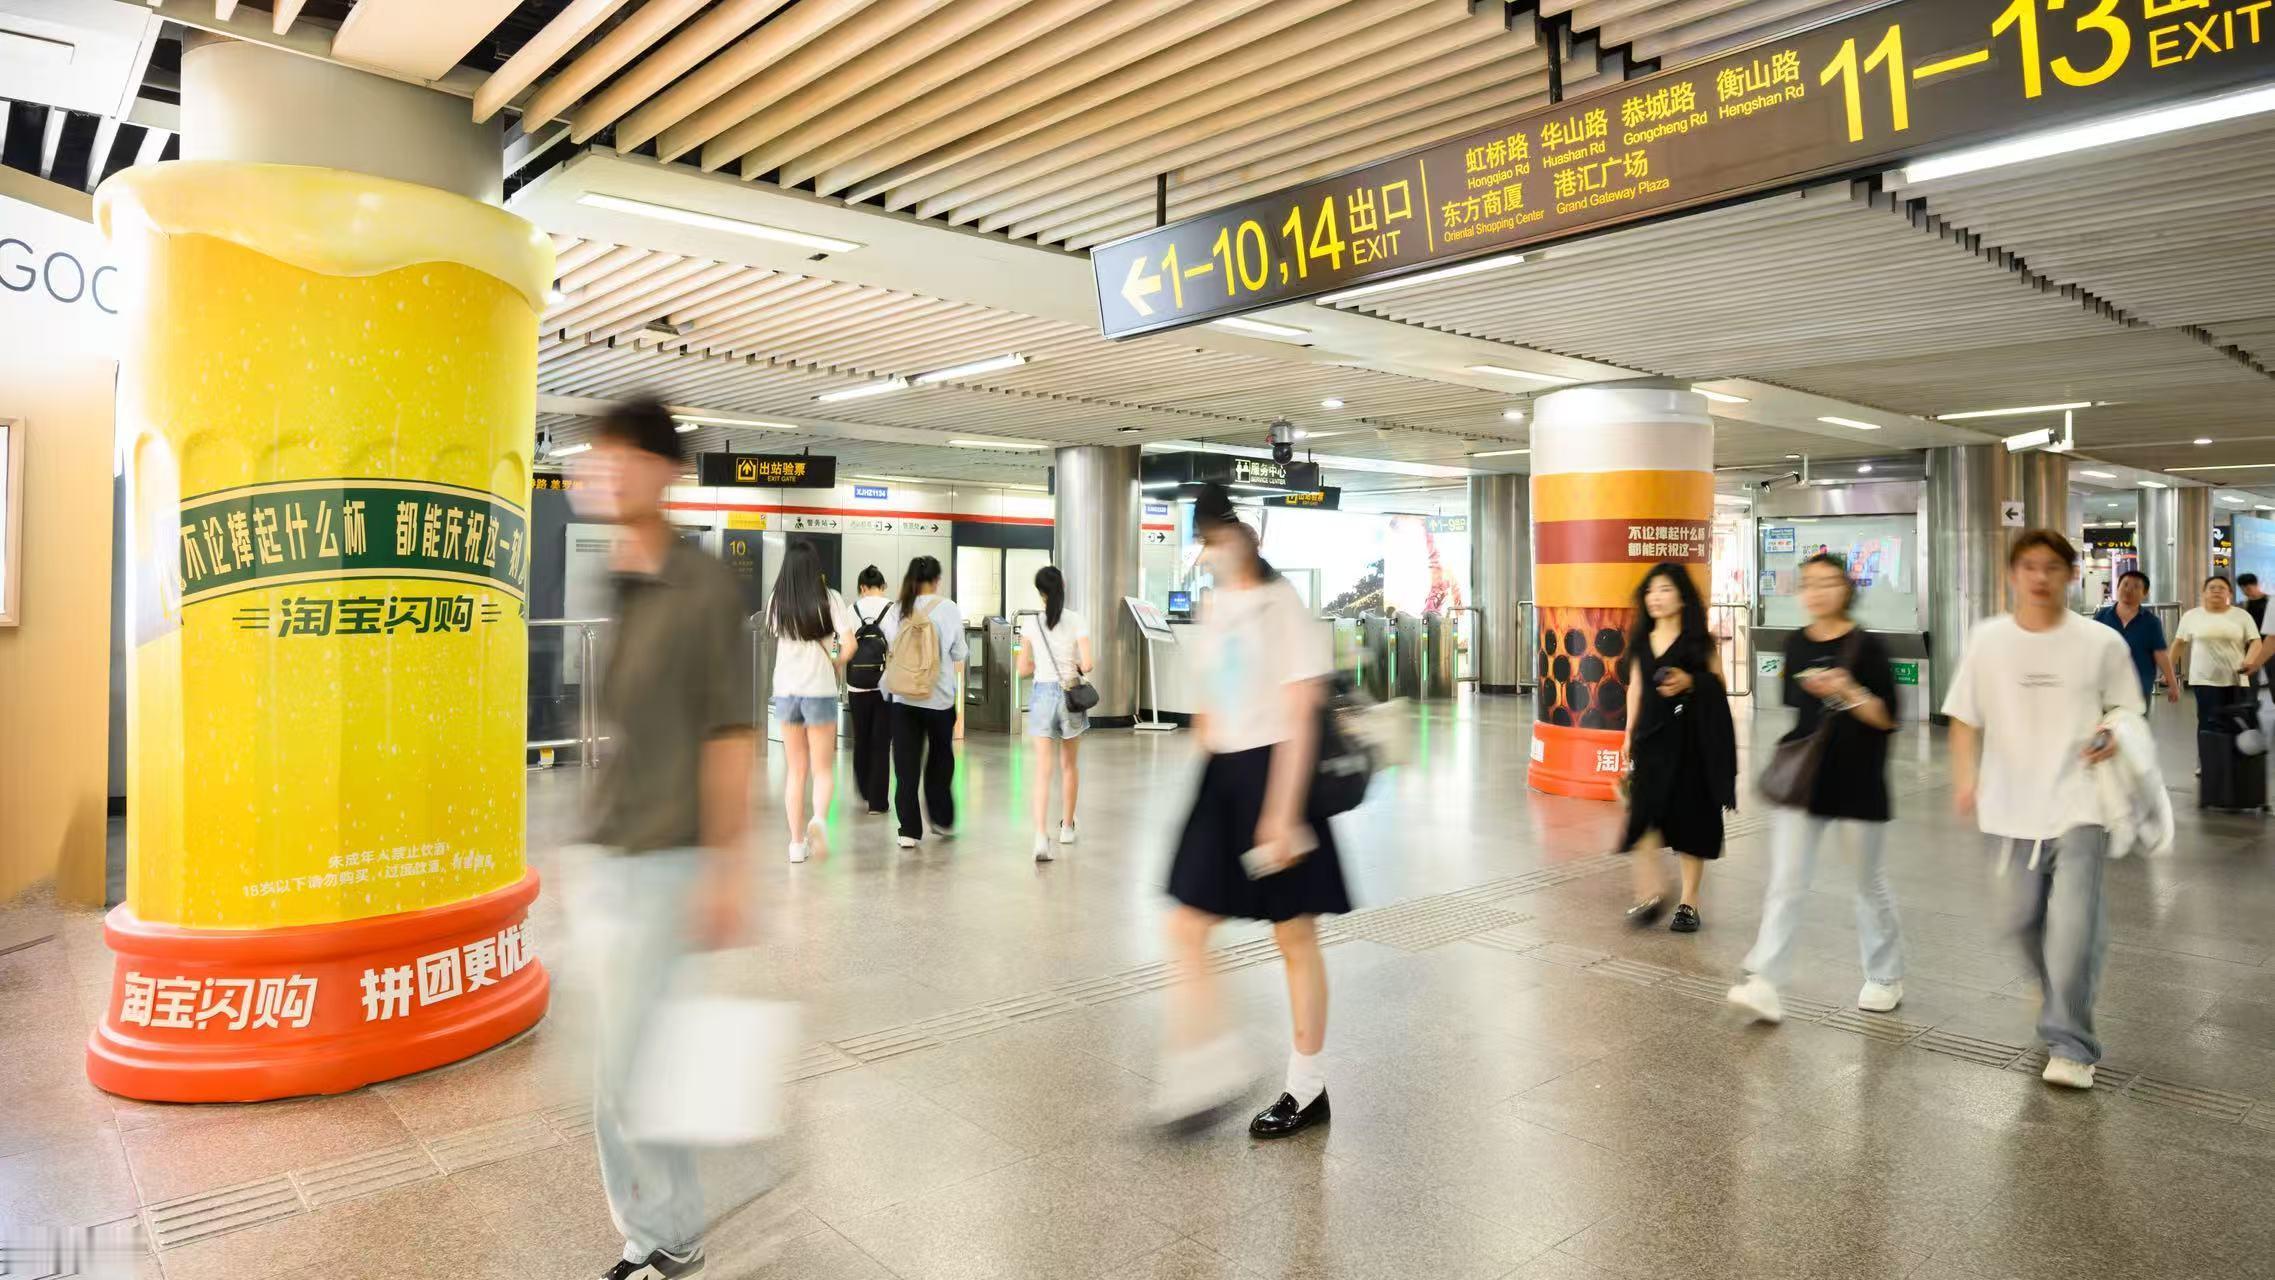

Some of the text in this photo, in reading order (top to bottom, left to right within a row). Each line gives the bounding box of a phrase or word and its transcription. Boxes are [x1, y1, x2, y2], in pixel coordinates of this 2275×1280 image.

[2149, 0, 2272, 68] EXIT
[1465, 49, 1800, 174] 虹桥路 华山路 恭城路 衡山路
[1468, 83, 1805, 189] Hongqiao Rd Huashan Rd Gongcheng Rd Hengshan Rd
[1348, 180, 1412, 235] 出口
[1442, 149, 1649, 228] 东方商厦 港汇广场
[1444, 178, 1670, 243] Oriental Shopping Center Grand Gateway Plaza
[1352, 229, 1401, 265] EXIT
[760, 461, 807, 477] 出站验票
[781, 475, 796, 483] GATE
[179, 499, 525, 586] 不论捧起什么杯 都能庆祝这一刻
[729, 540, 746, 556] 10
[278, 595, 474, 638] 淘宝闪购
[118, 971, 319, 1031] 淘宝闪购
